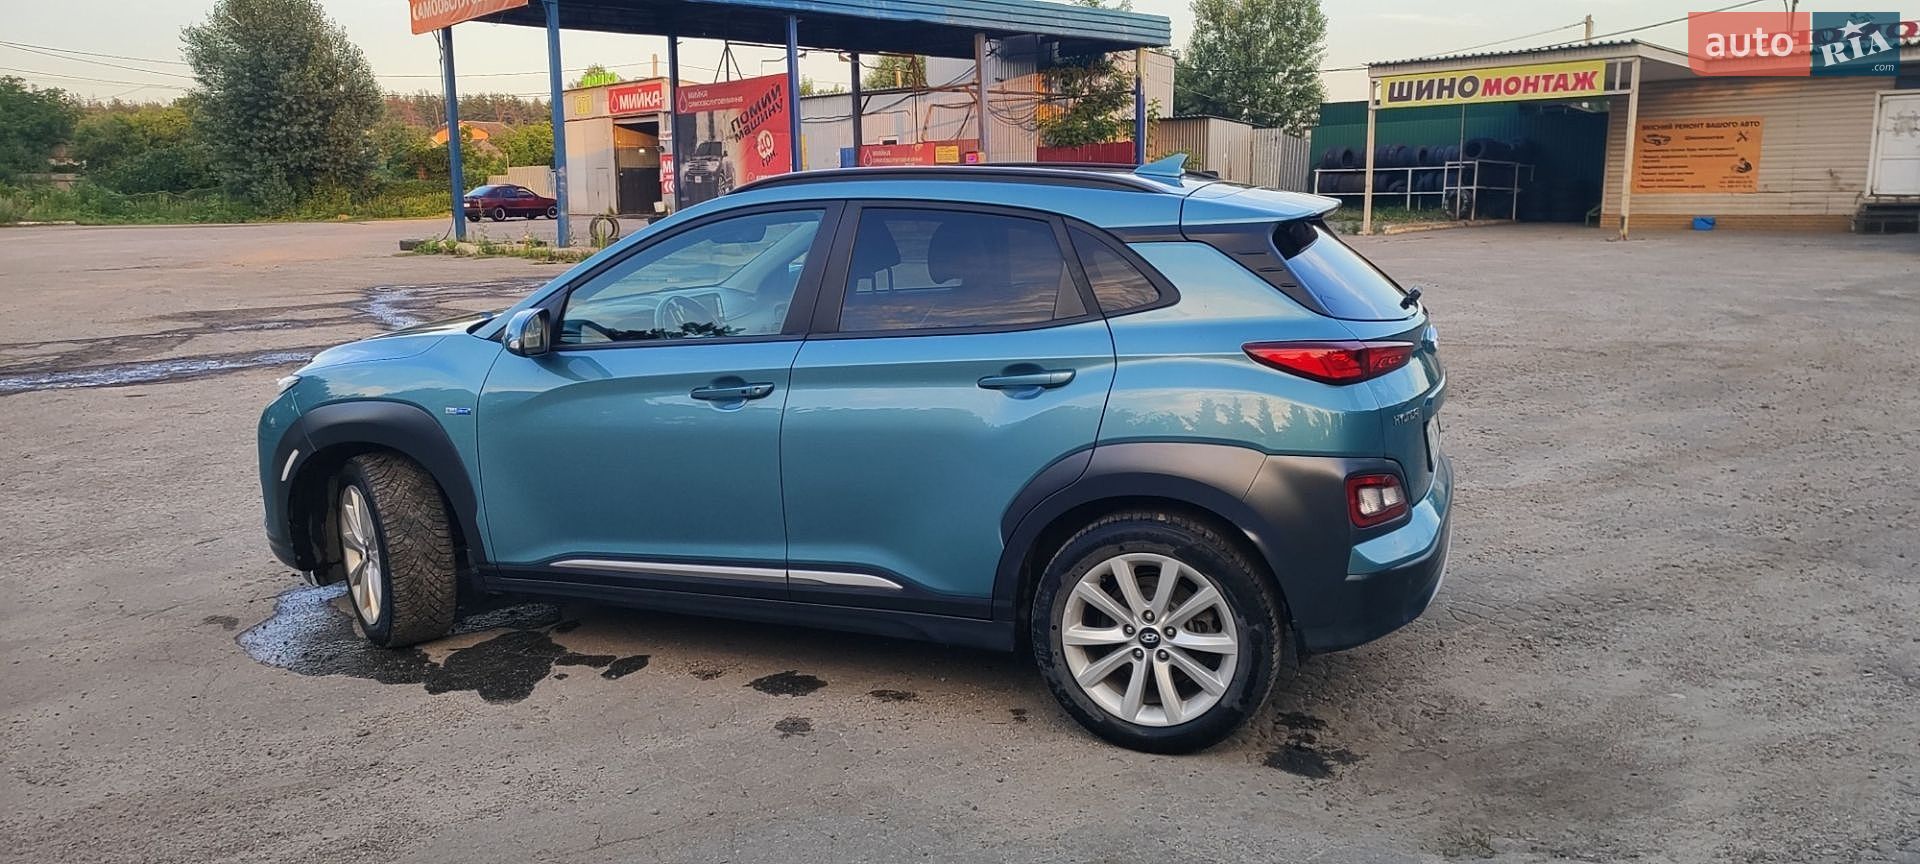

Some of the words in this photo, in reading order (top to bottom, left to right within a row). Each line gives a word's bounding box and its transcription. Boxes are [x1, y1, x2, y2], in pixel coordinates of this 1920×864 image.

[619, 89, 661, 110] МИЙКА
[730, 82, 782, 132] ПОМИЙ
[758, 133, 772, 152] 40
